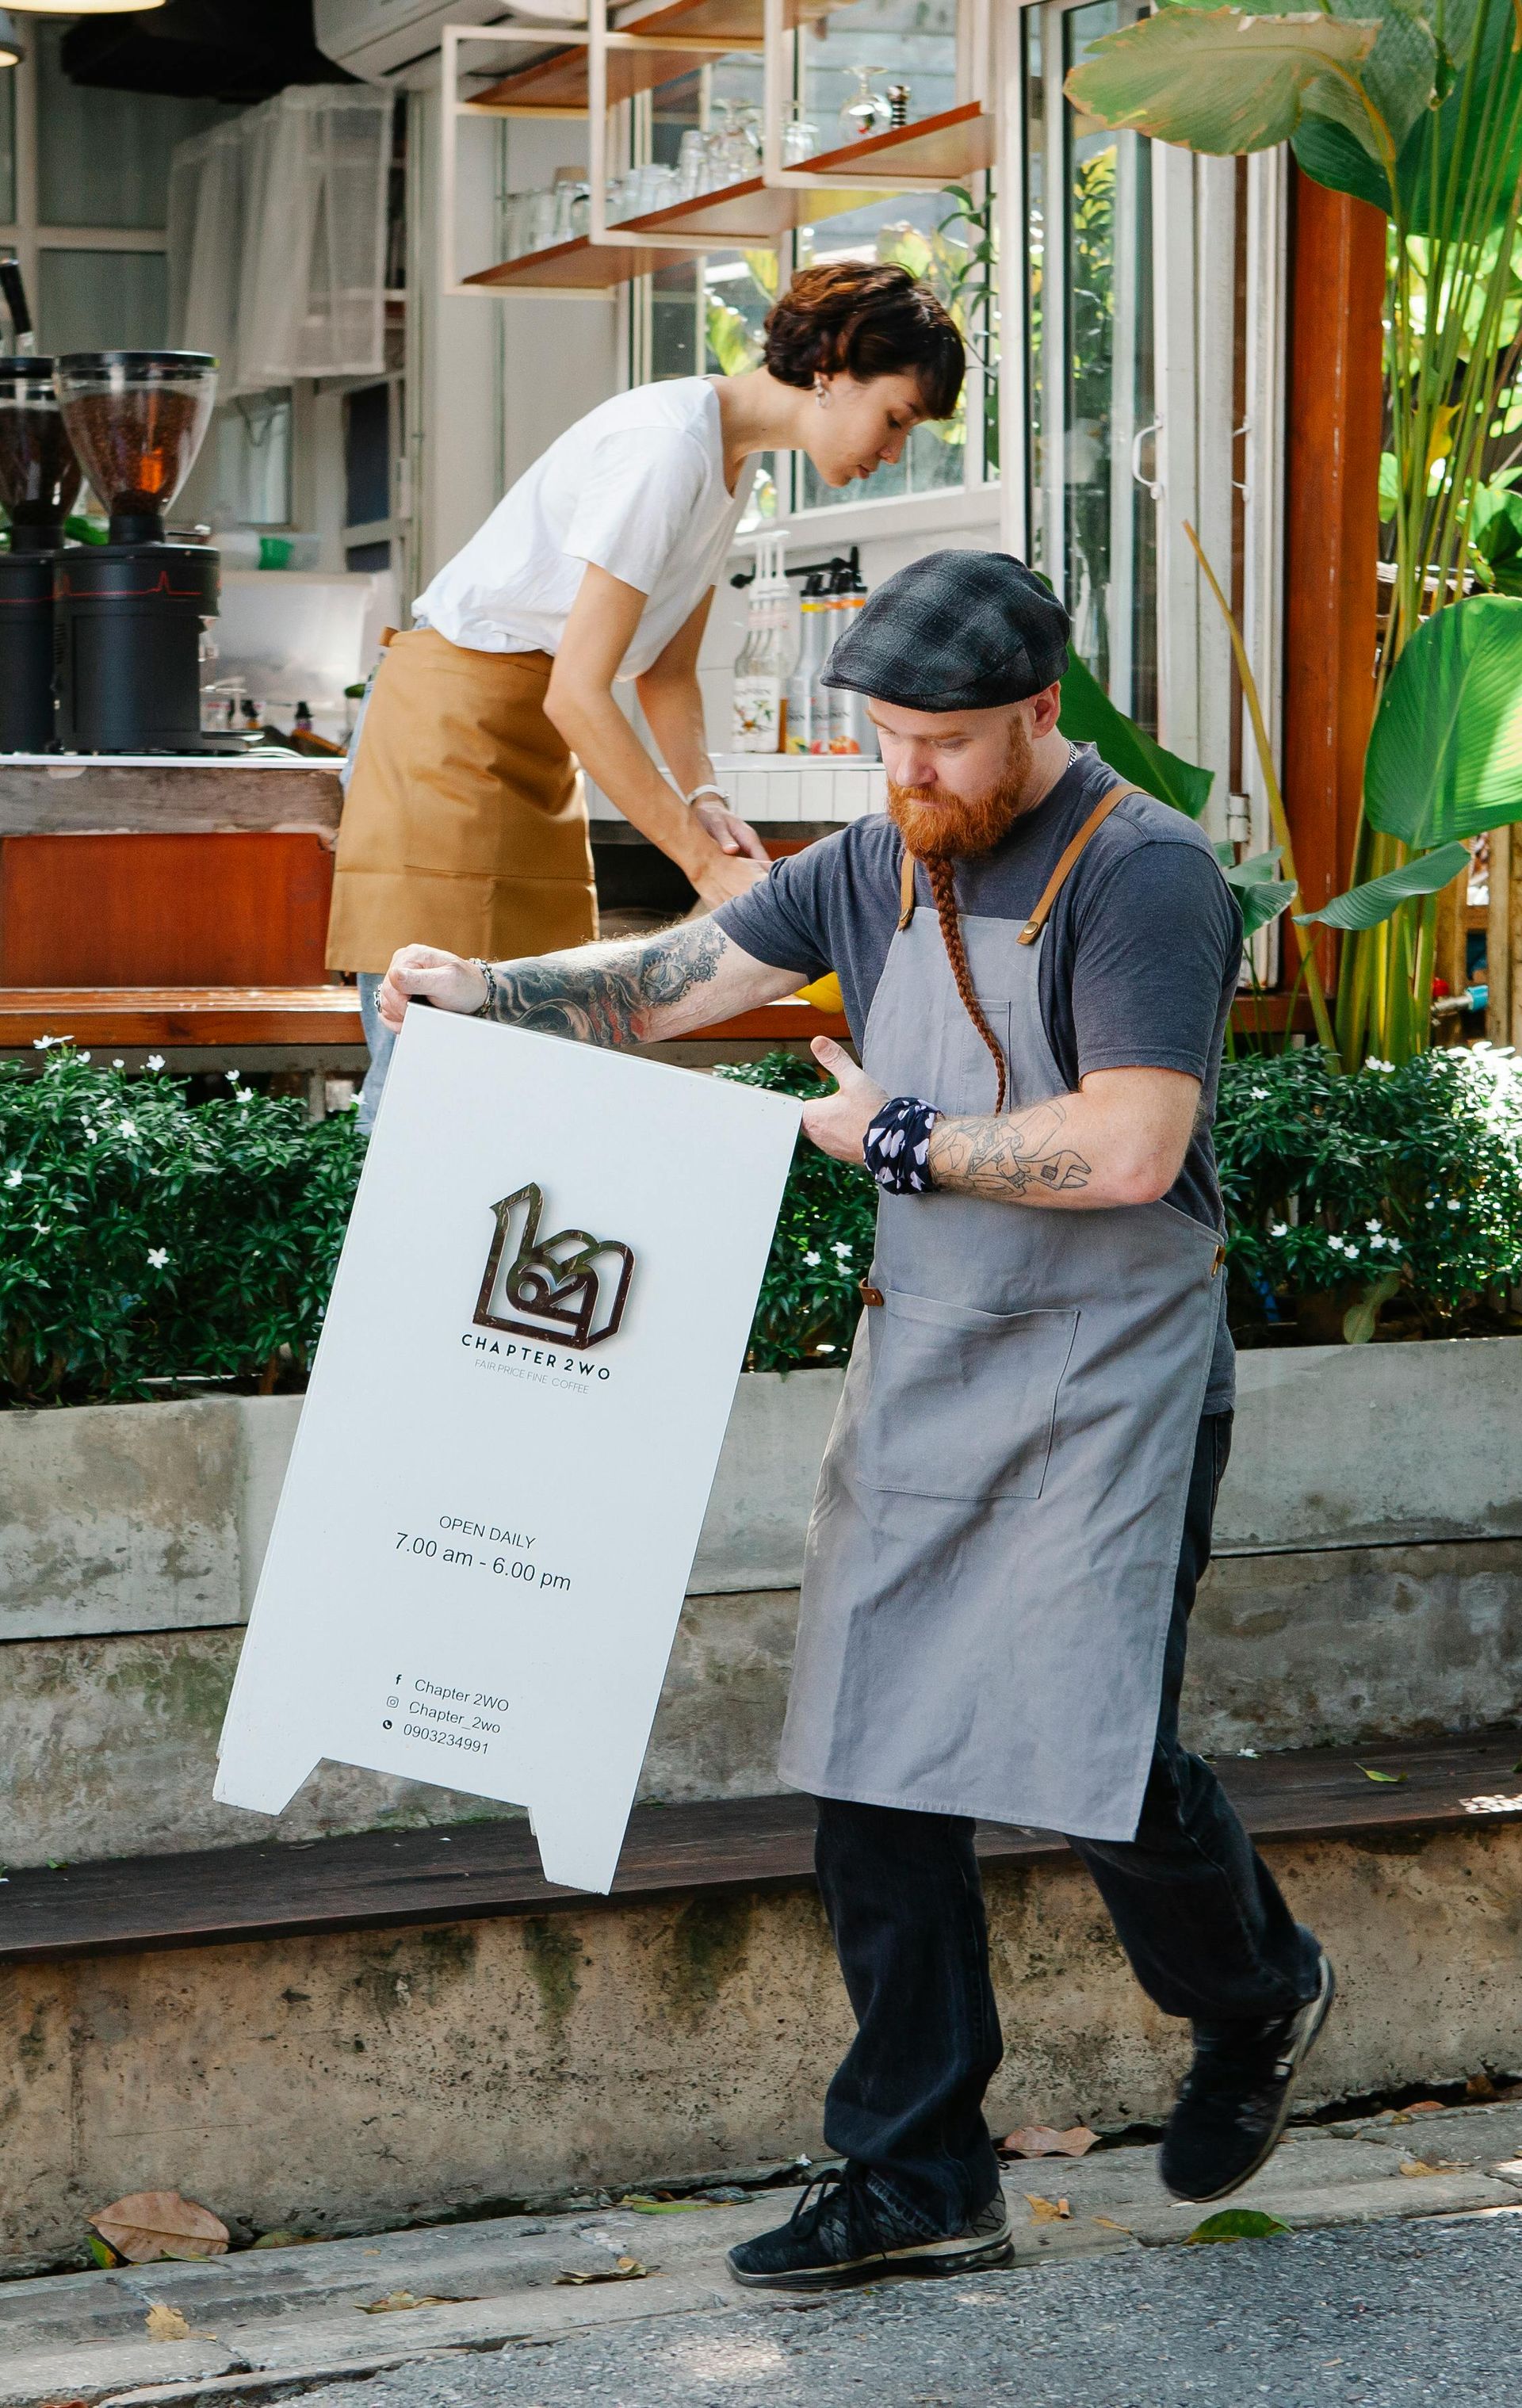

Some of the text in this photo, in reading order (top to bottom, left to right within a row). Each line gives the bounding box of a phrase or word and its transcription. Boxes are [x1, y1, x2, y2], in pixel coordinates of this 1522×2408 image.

[474, 1359, 590, 1394] FAIR PRICE FINE COFFEE
[439, 1516, 537, 1550] OPEN DAILY
[396, 1532, 438, 1558] 7.00
[442, 1548, 473, 1567] am
[492, 1557, 536, 1582] 6.00
[539, 1572, 572, 1592] pm
[415, 1679, 510, 1712] Chapter 2WO
[409, 1701, 501, 1734] Chapter_2wo
[403, 1723, 488, 1755] 0903234991
